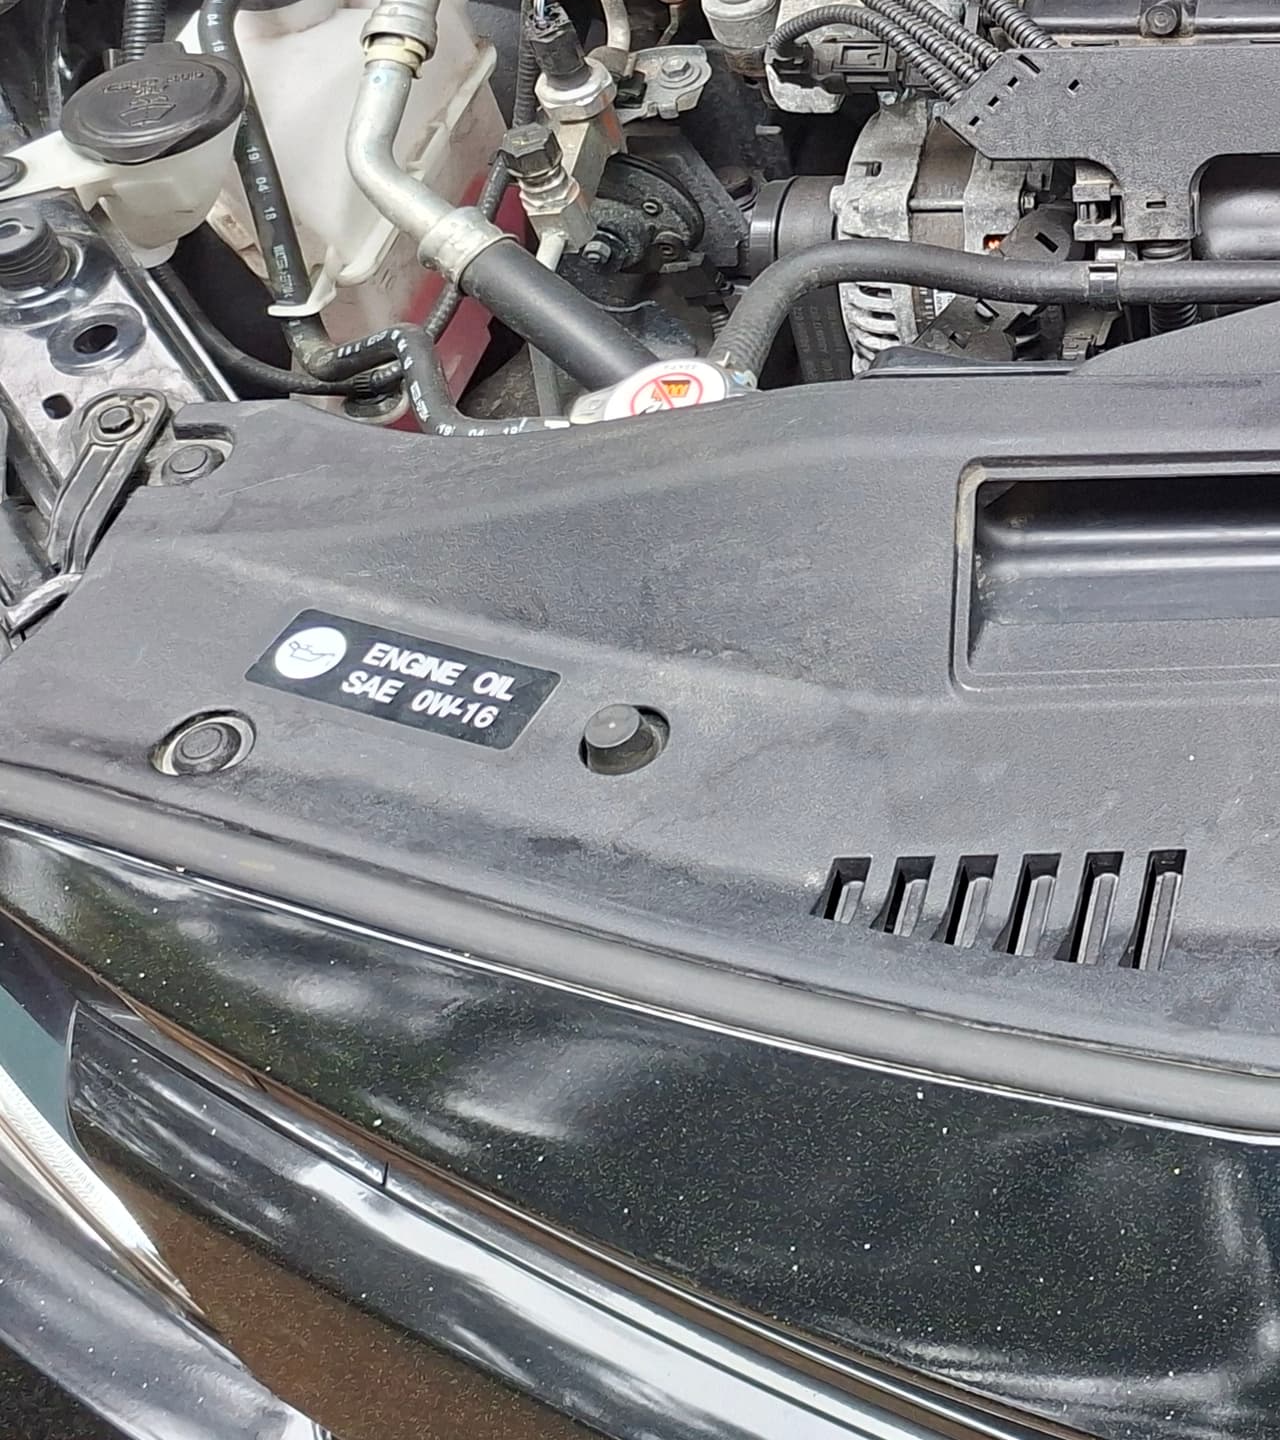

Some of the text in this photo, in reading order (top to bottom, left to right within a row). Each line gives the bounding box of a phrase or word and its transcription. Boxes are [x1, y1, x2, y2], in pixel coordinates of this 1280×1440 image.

[340, 670, 500, 729] SAE 0W-16
[362, 642, 516, 702] ENGINE OIL
